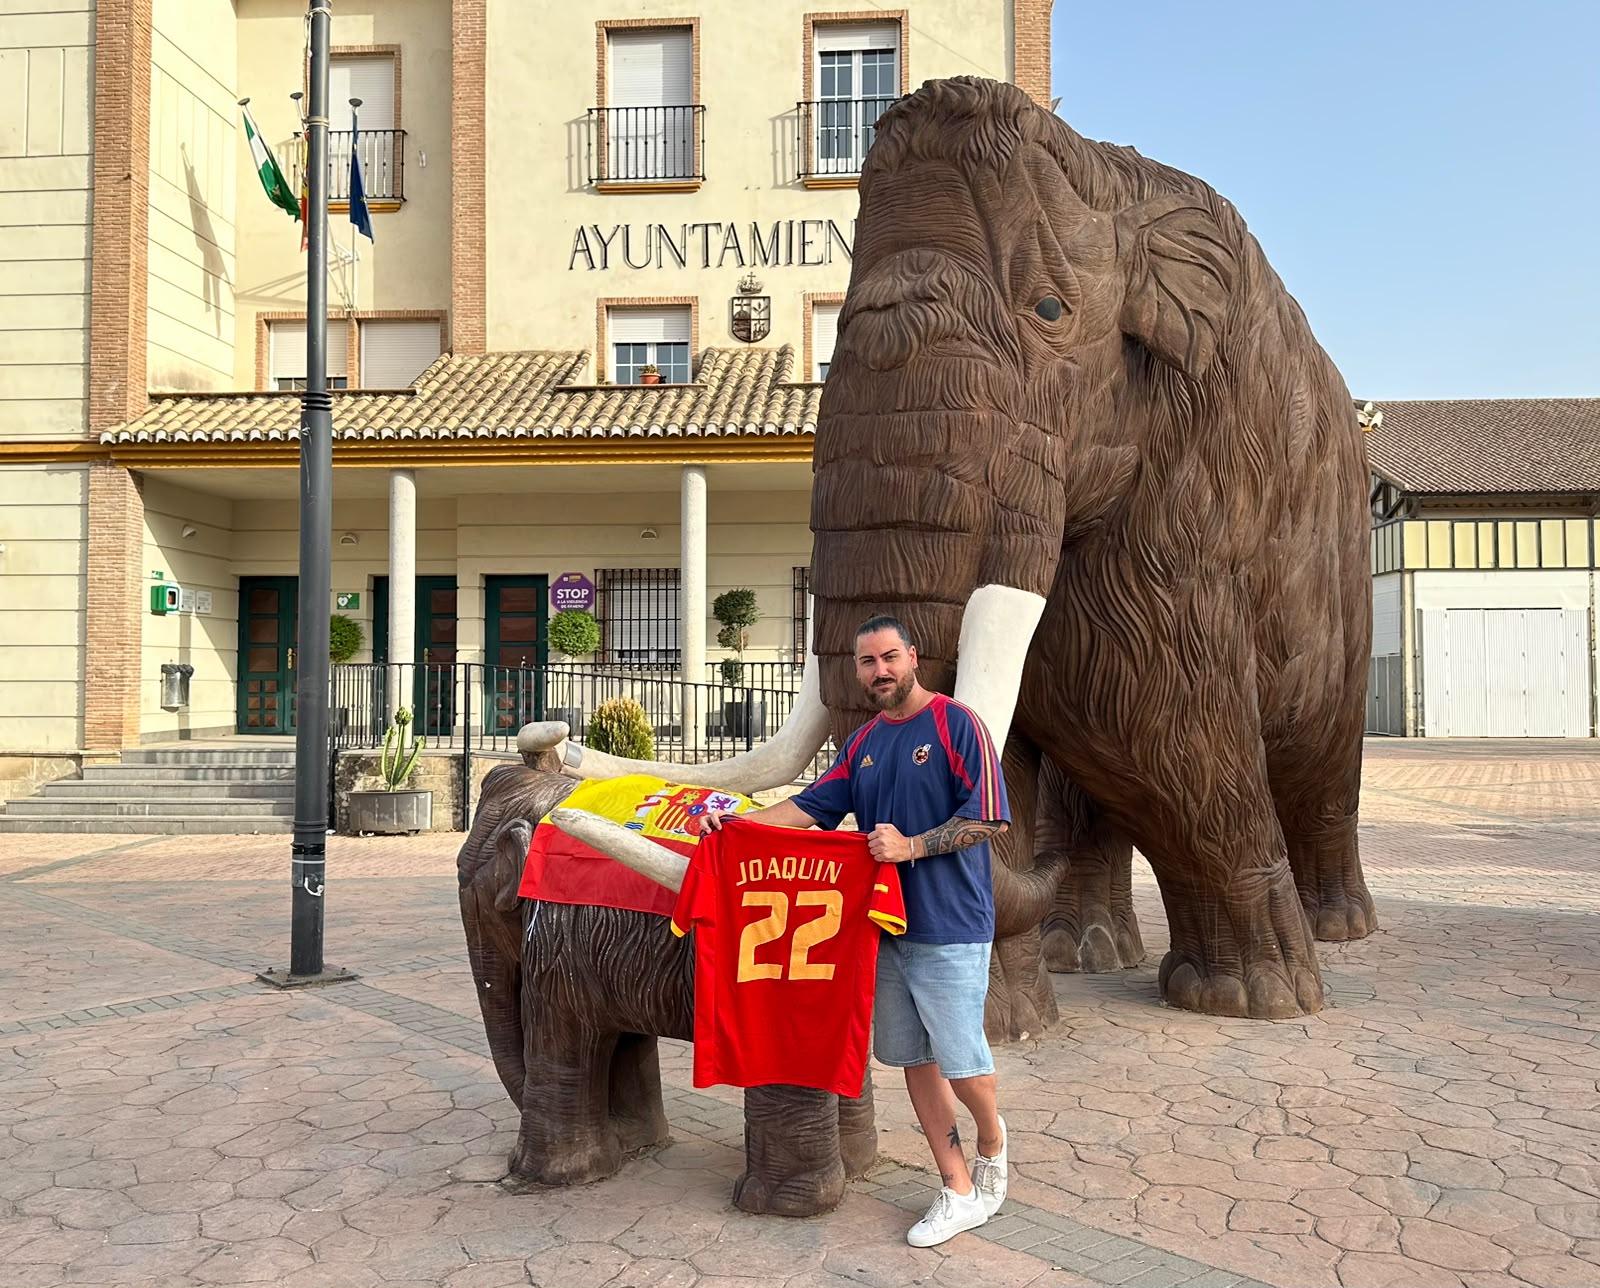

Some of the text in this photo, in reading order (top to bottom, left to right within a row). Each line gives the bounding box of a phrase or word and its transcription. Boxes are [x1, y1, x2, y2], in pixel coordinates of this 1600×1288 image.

[556, 588, 589, 599] STOP
[736, 857, 843, 887] JOAQUIN
[737, 890, 844, 983] 22
